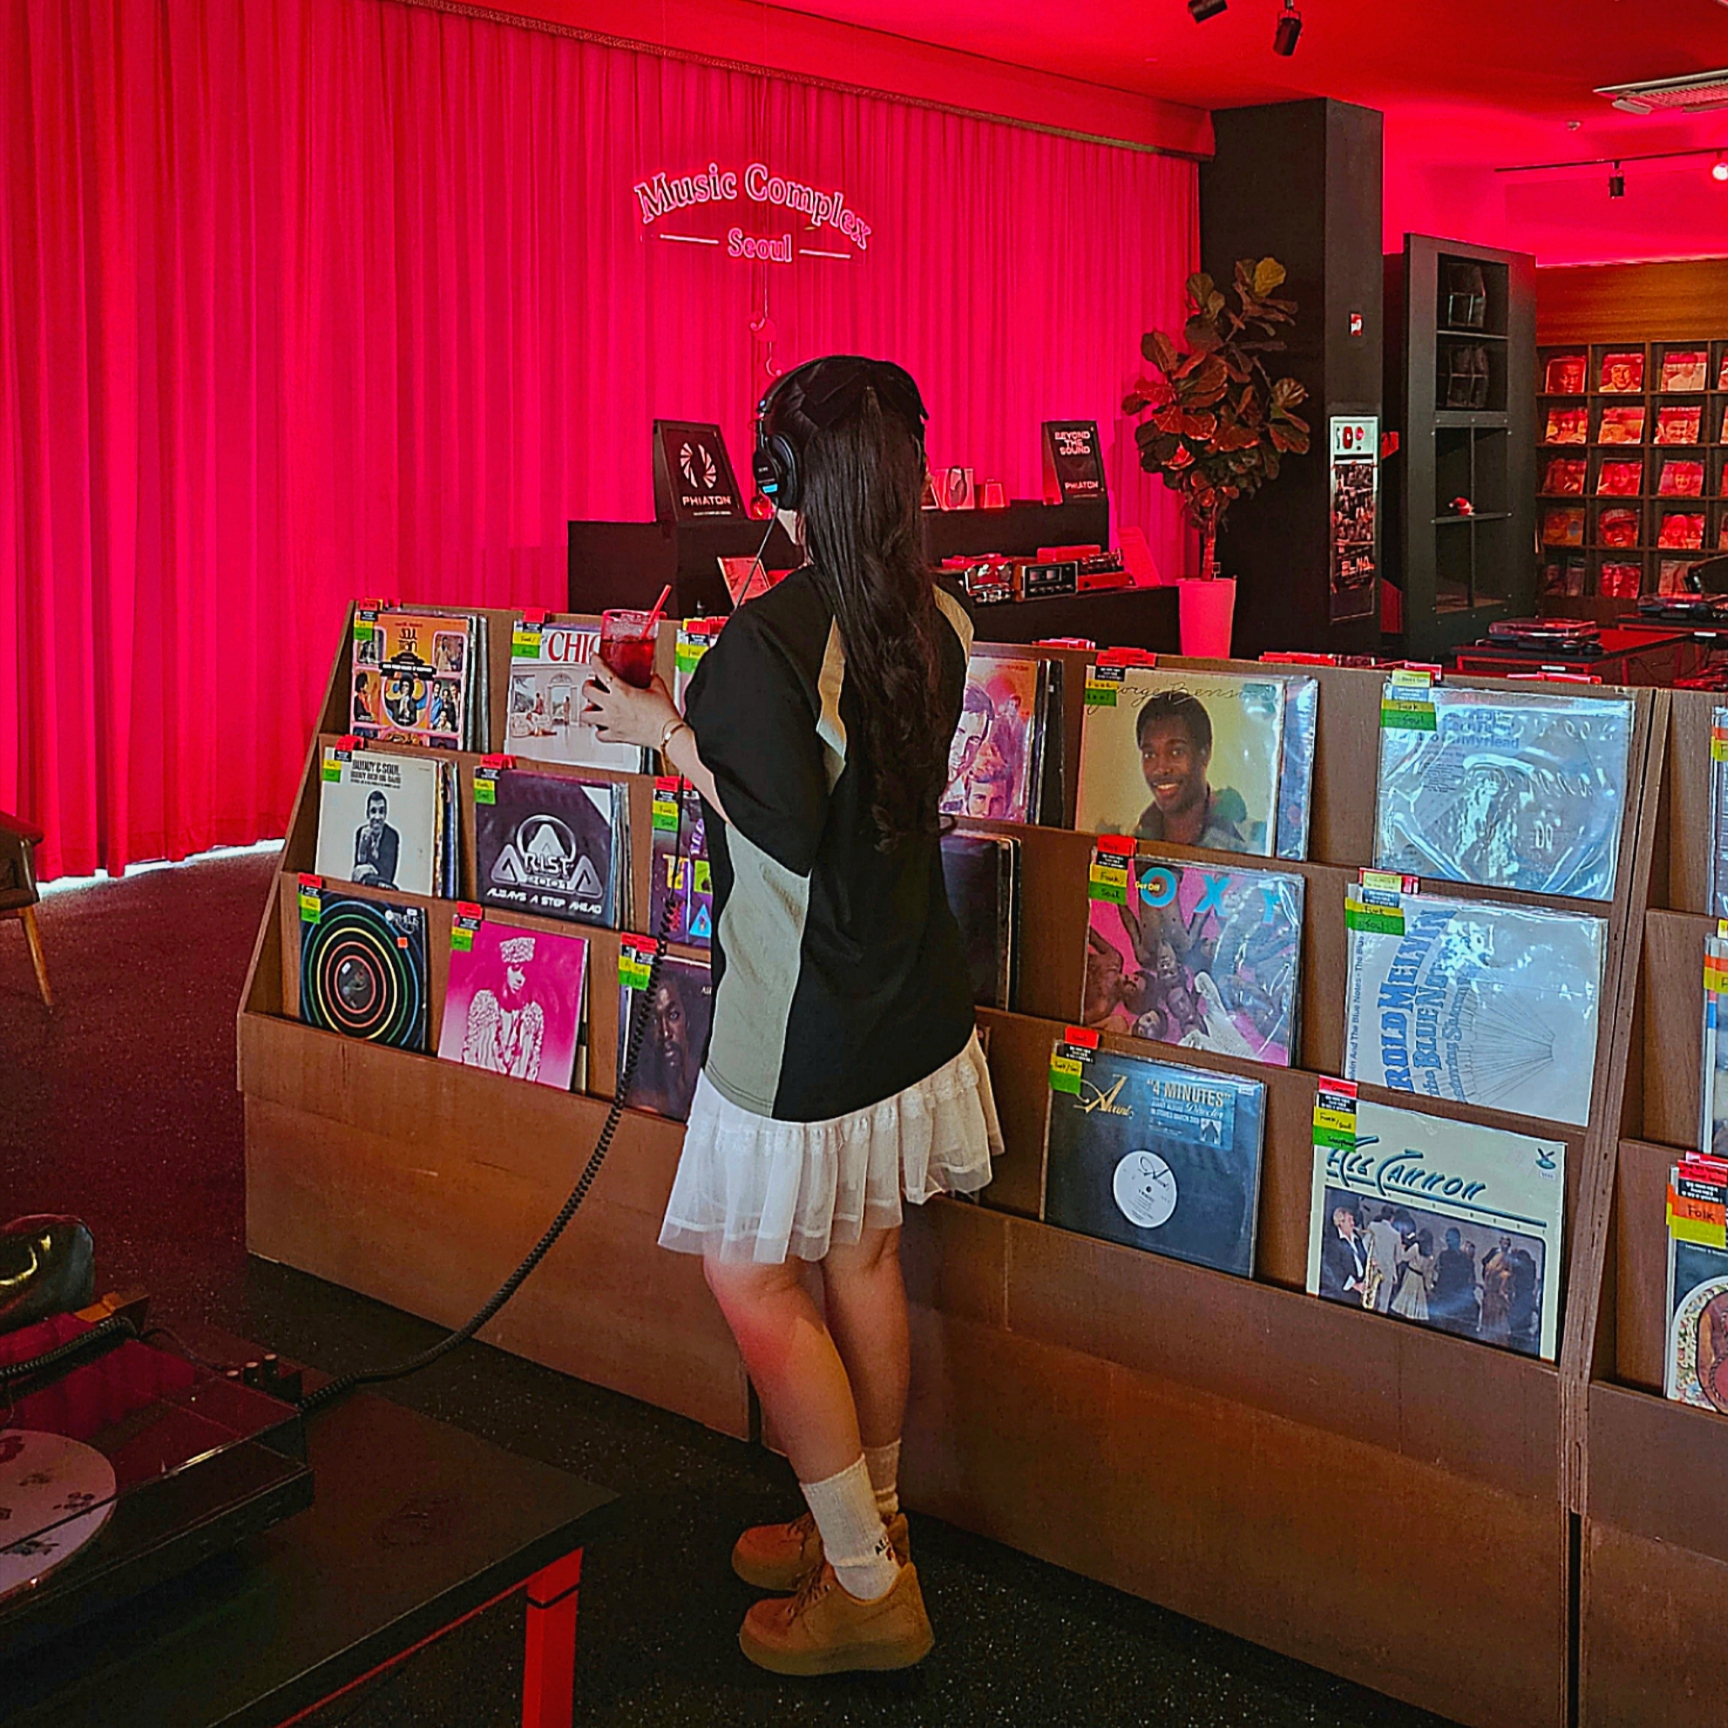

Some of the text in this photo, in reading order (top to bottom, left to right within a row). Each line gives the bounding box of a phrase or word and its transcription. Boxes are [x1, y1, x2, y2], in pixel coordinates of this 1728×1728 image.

[634, 162, 872, 250] Music Complex
[727, 227, 792, 263] Seoul
[1059, 446, 1091, 456] SOUND
[1064, 439, 1084, 447] THE
[682, 495, 732, 507] PHIATON
[487, 887, 602, 914] ALWAYS A STEP AHEAD
[1377, 909, 1458, 1013] MELVIN
[1353, 978, 1362, 1004] Notes
[1351, 1006, 1360, 1024] Blue
[1350, 1025, 1359, 1041] The
[1412, 1007, 1443, 1070] BLUE
[1350, 1042, 1358, 1060] And
[1375, 1148, 1487, 1201] CANNON
[1687, 1204, 1716, 1222] Folk
